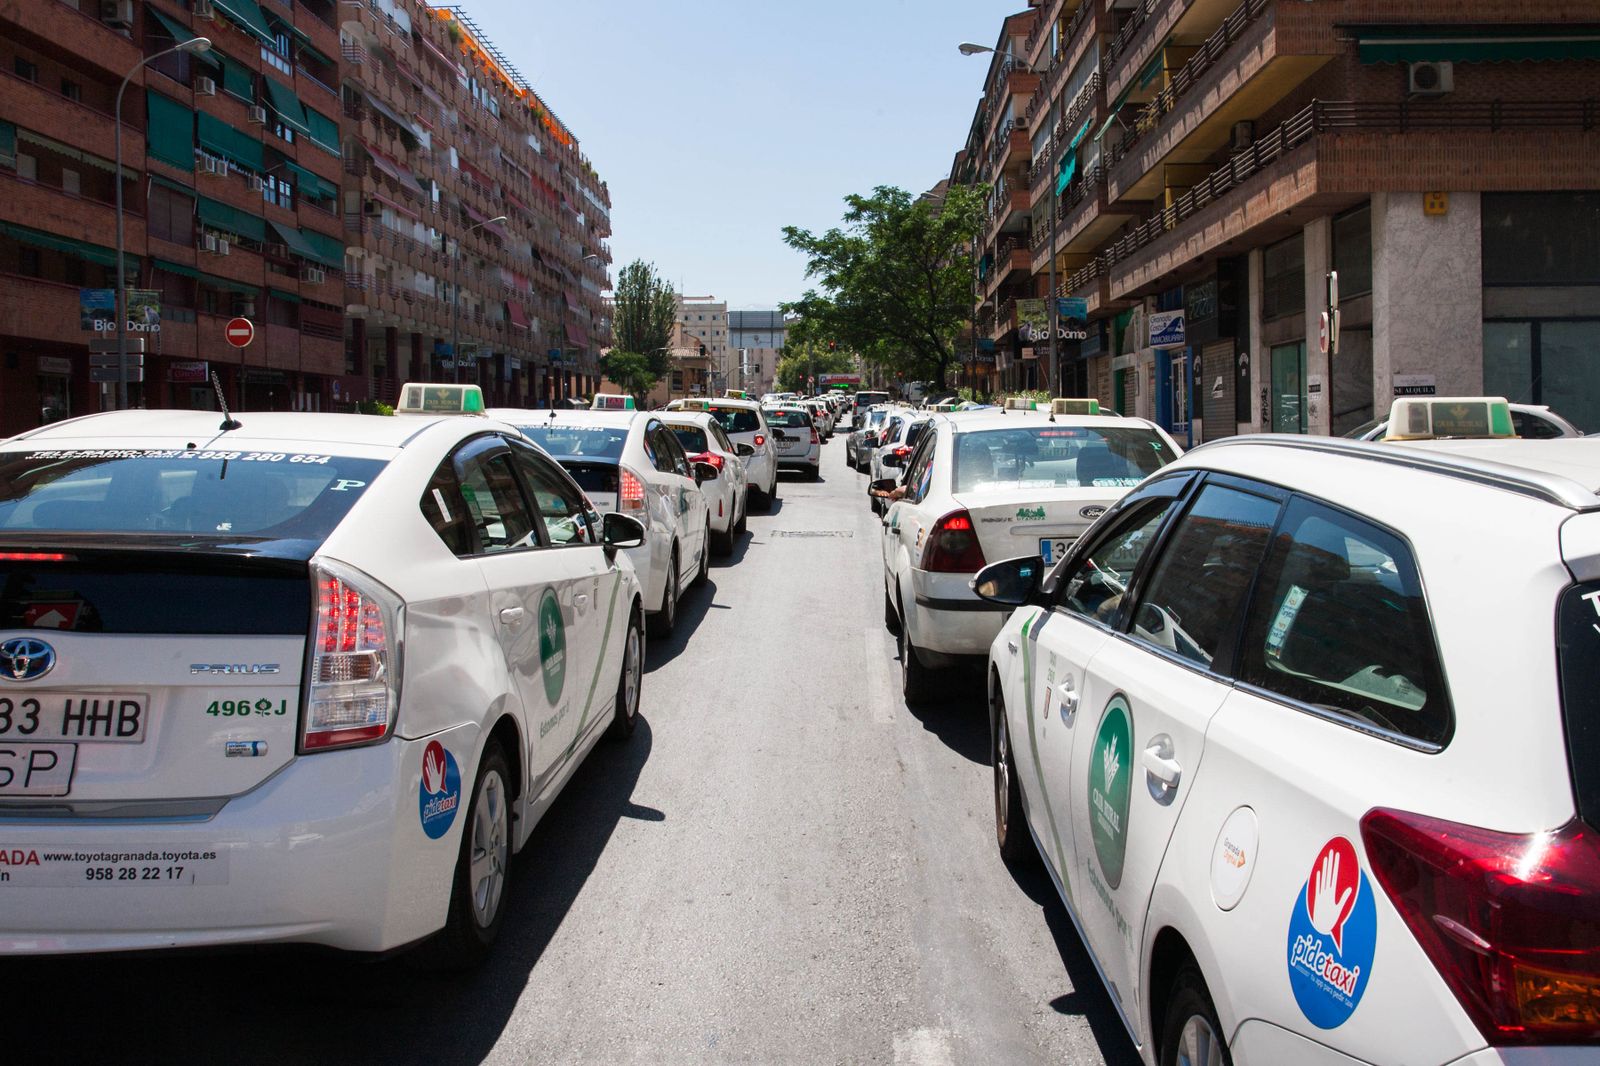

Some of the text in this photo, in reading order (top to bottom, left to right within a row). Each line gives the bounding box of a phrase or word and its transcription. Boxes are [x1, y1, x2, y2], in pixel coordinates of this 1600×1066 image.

[94, 319, 160, 332] Bio Domo
[1057, 328, 1088, 340] Domo
[1404, 386, 1435, 394] ALQUILA
[198, 451, 241, 460] 958
[242, 452, 286, 462] 280
[289, 455, 332, 464] 654
[330, 479, 366, 491] P
[190, 663, 280, 675] PRIUS
[206, 700, 251, 716] 496
[62, 699, 141, 737] HHB
[423, 791, 458, 824] pidetaxi
[43, 851, 217, 864] www.toyotagranada.toyota.es
[86, 868, 113, 881] 958
[118, 868, 137, 880] 28
[142, 867, 161, 880] 22
[166, 866, 184, 880] 17
[1290, 934, 1361, 998] pidetaxi
